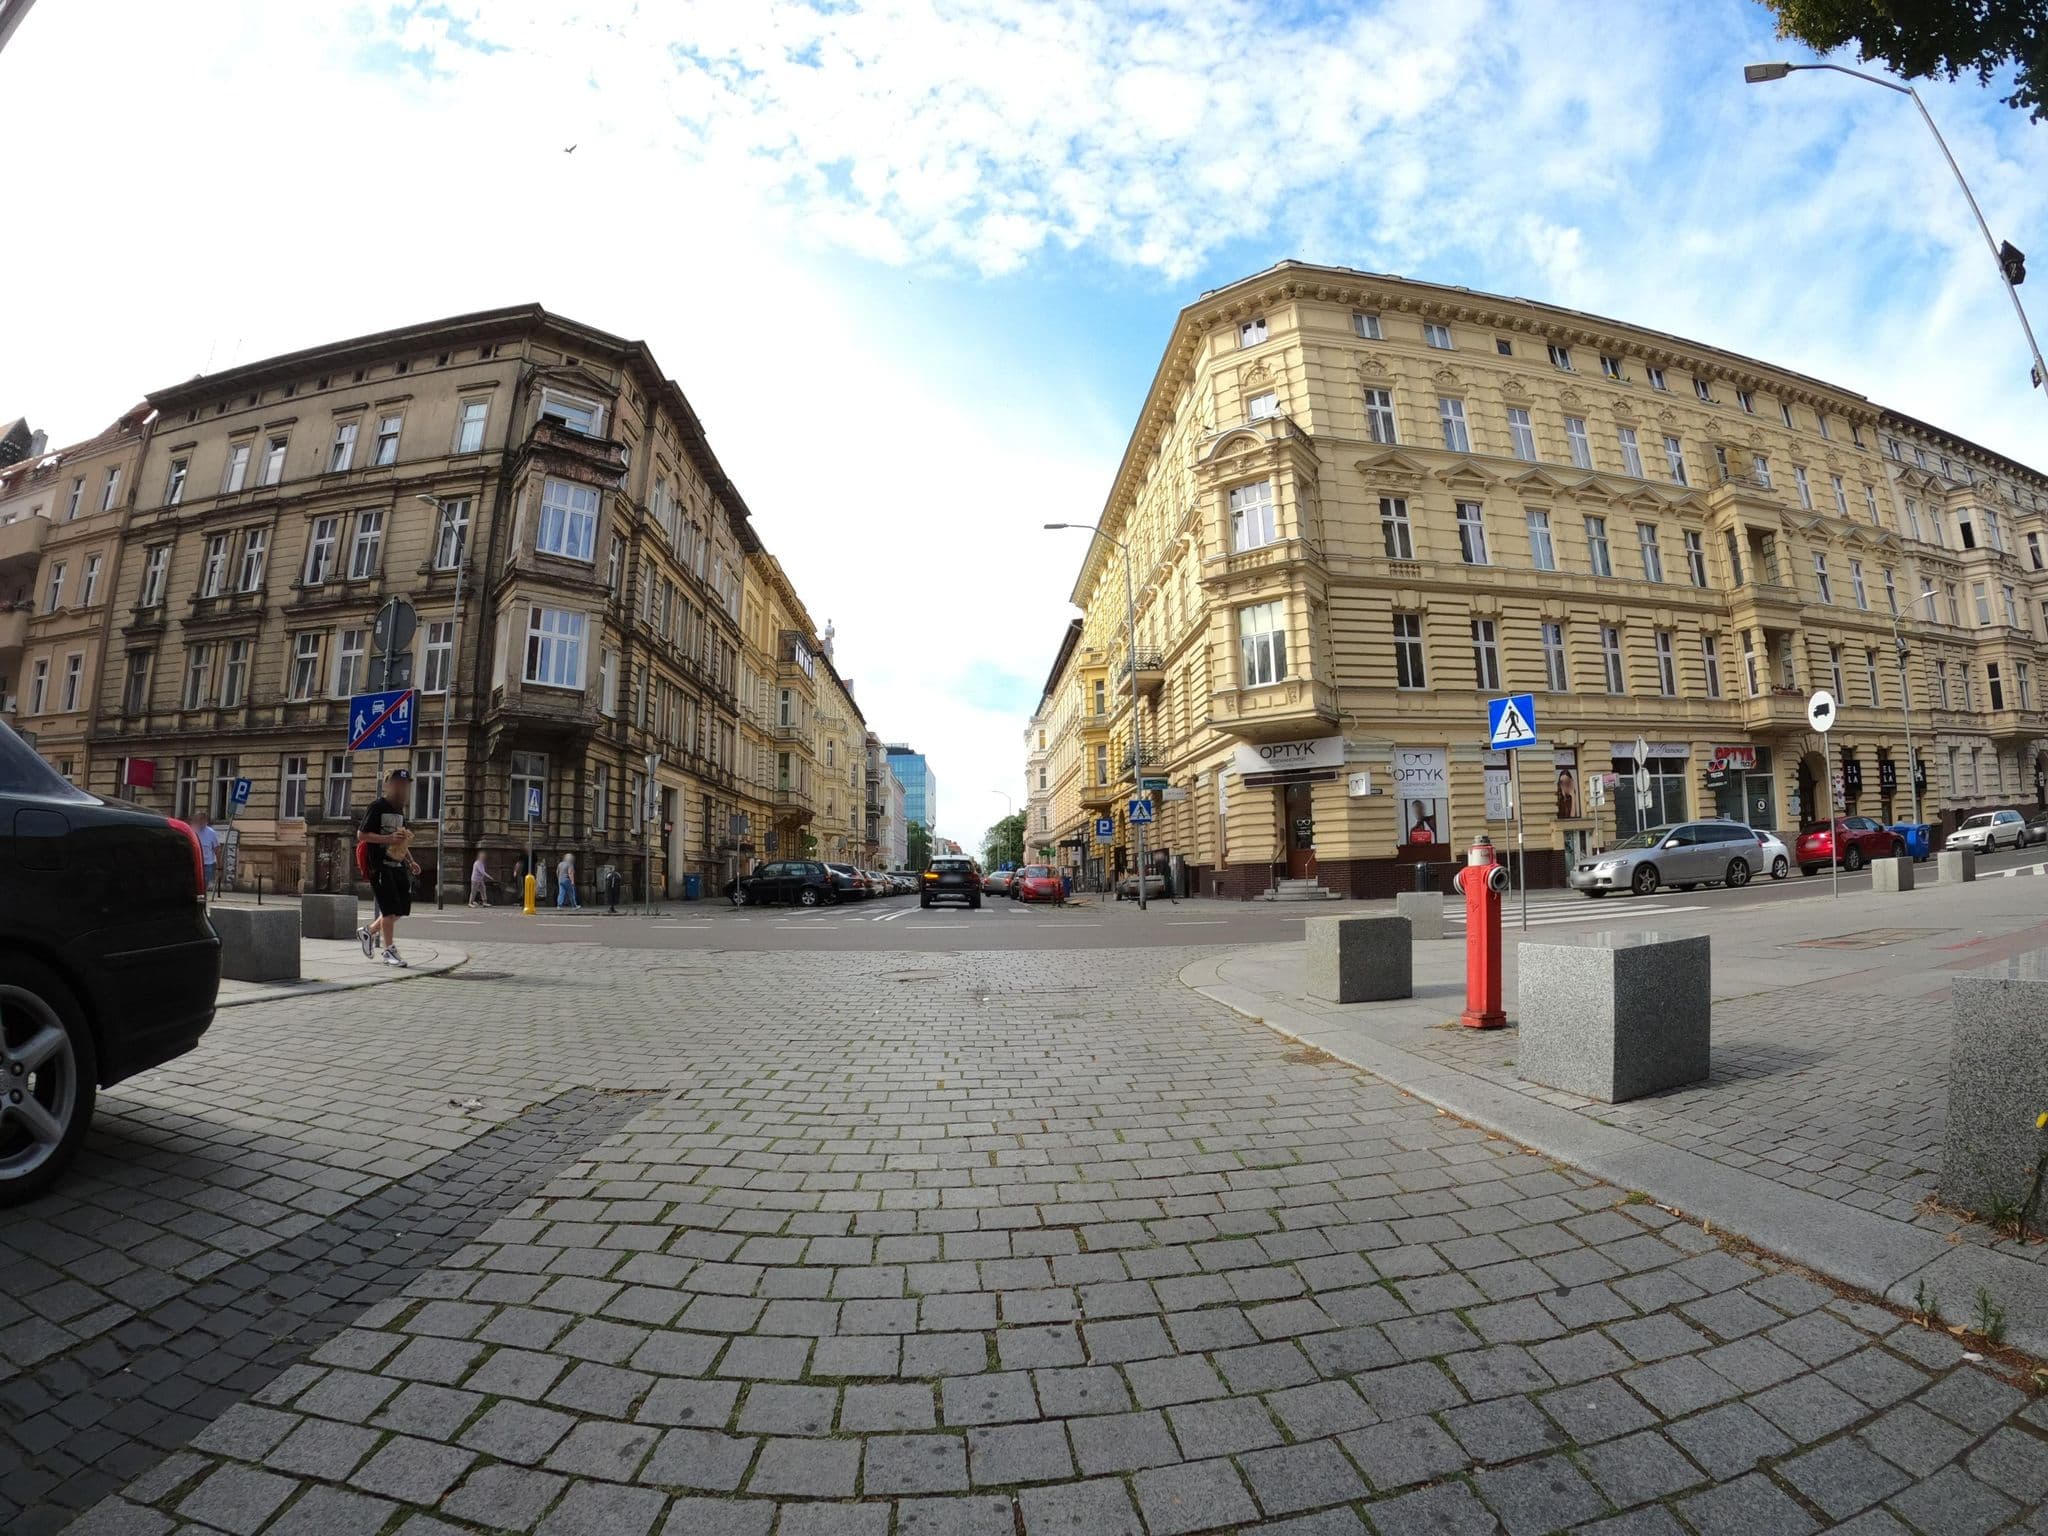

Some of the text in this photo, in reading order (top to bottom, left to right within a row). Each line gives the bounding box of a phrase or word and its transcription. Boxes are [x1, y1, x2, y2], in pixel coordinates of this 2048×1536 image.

[1260, 741, 1316, 759] OPTYK
[1715, 746, 1753, 761] OPTYK
[1393, 768, 1444, 782] OPTYK
[235, 781, 248, 799] P
[1099, 820, 1112, 834] P
